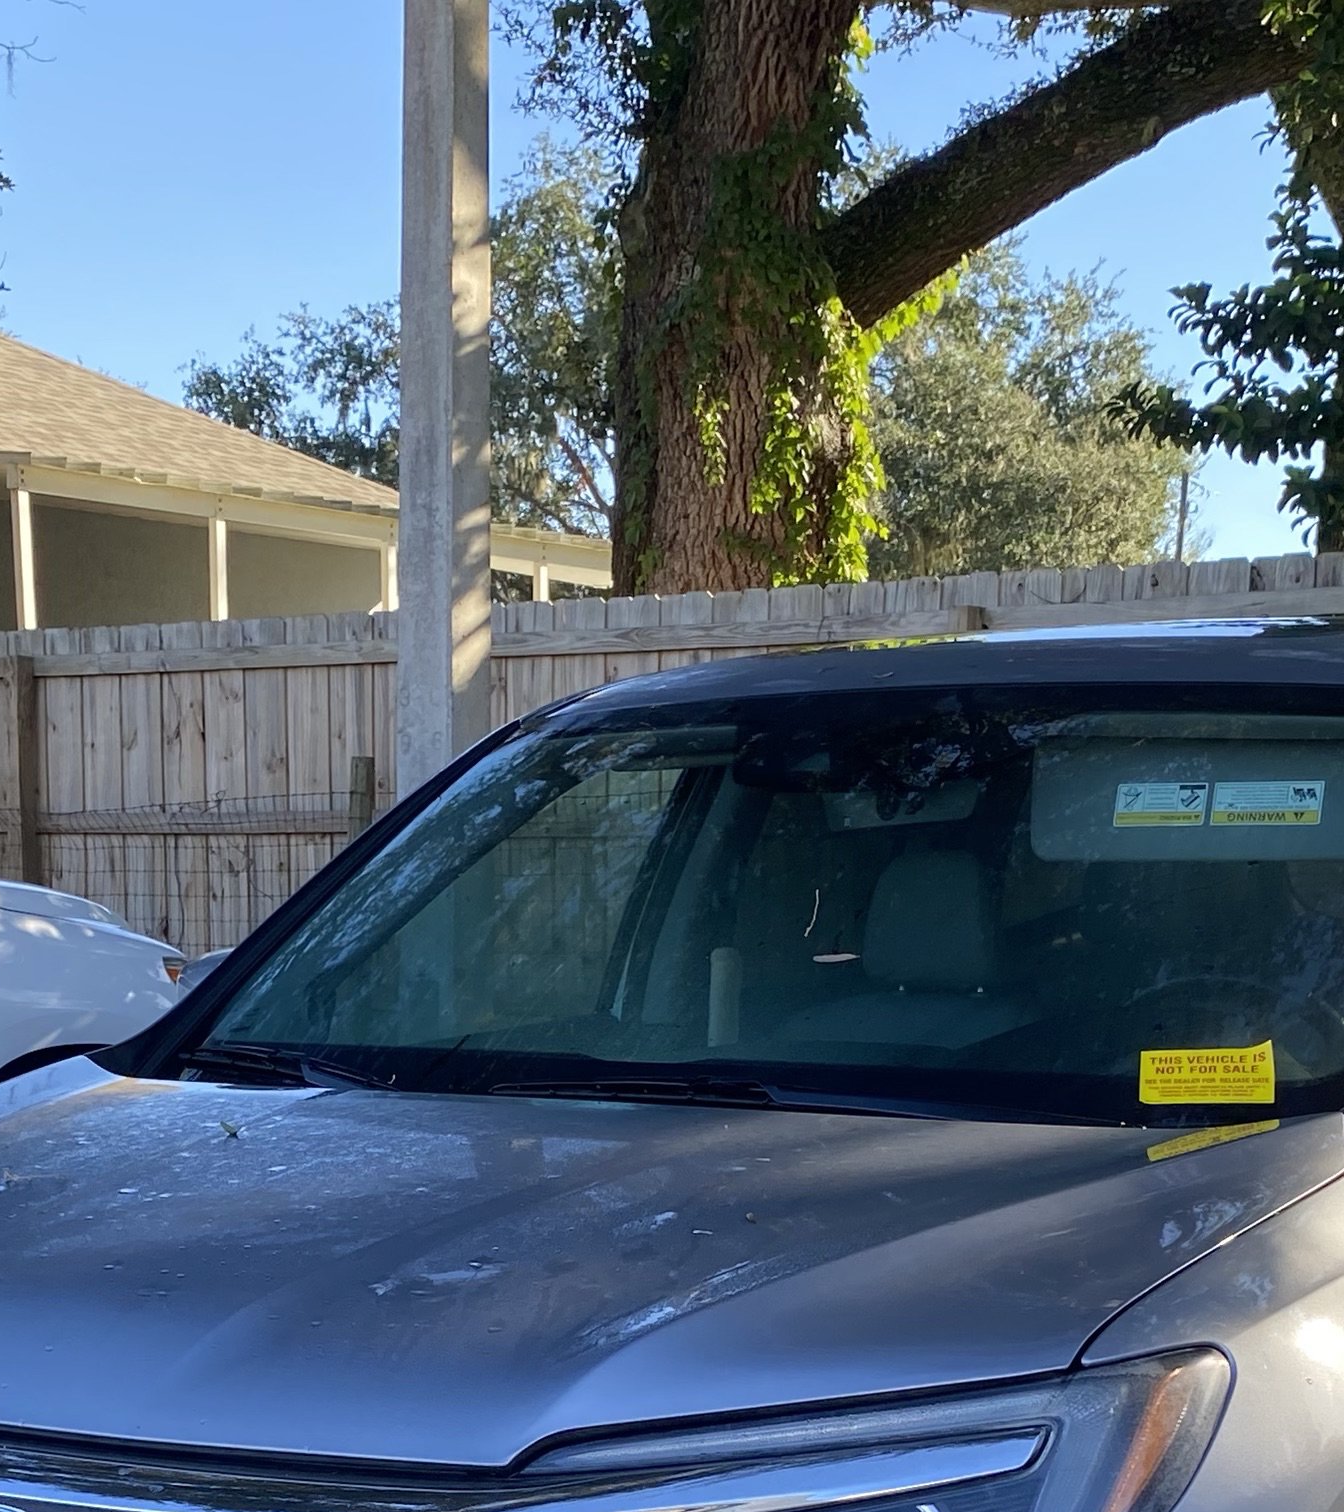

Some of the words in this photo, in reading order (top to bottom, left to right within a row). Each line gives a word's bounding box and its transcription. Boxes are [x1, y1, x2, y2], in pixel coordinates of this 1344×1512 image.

[1227, 812, 1286, 822] WARNING
[1150, 1057, 1182, 1065] THIS
[1187, 1055, 1248, 1064] VEHICLE
[1253, 1052, 1266, 1062] IS
[1155, 1066, 1183, 1074] NOT
[1189, 1065, 1217, 1073] FOR
[1223, 1065, 1260, 1073] SALE
